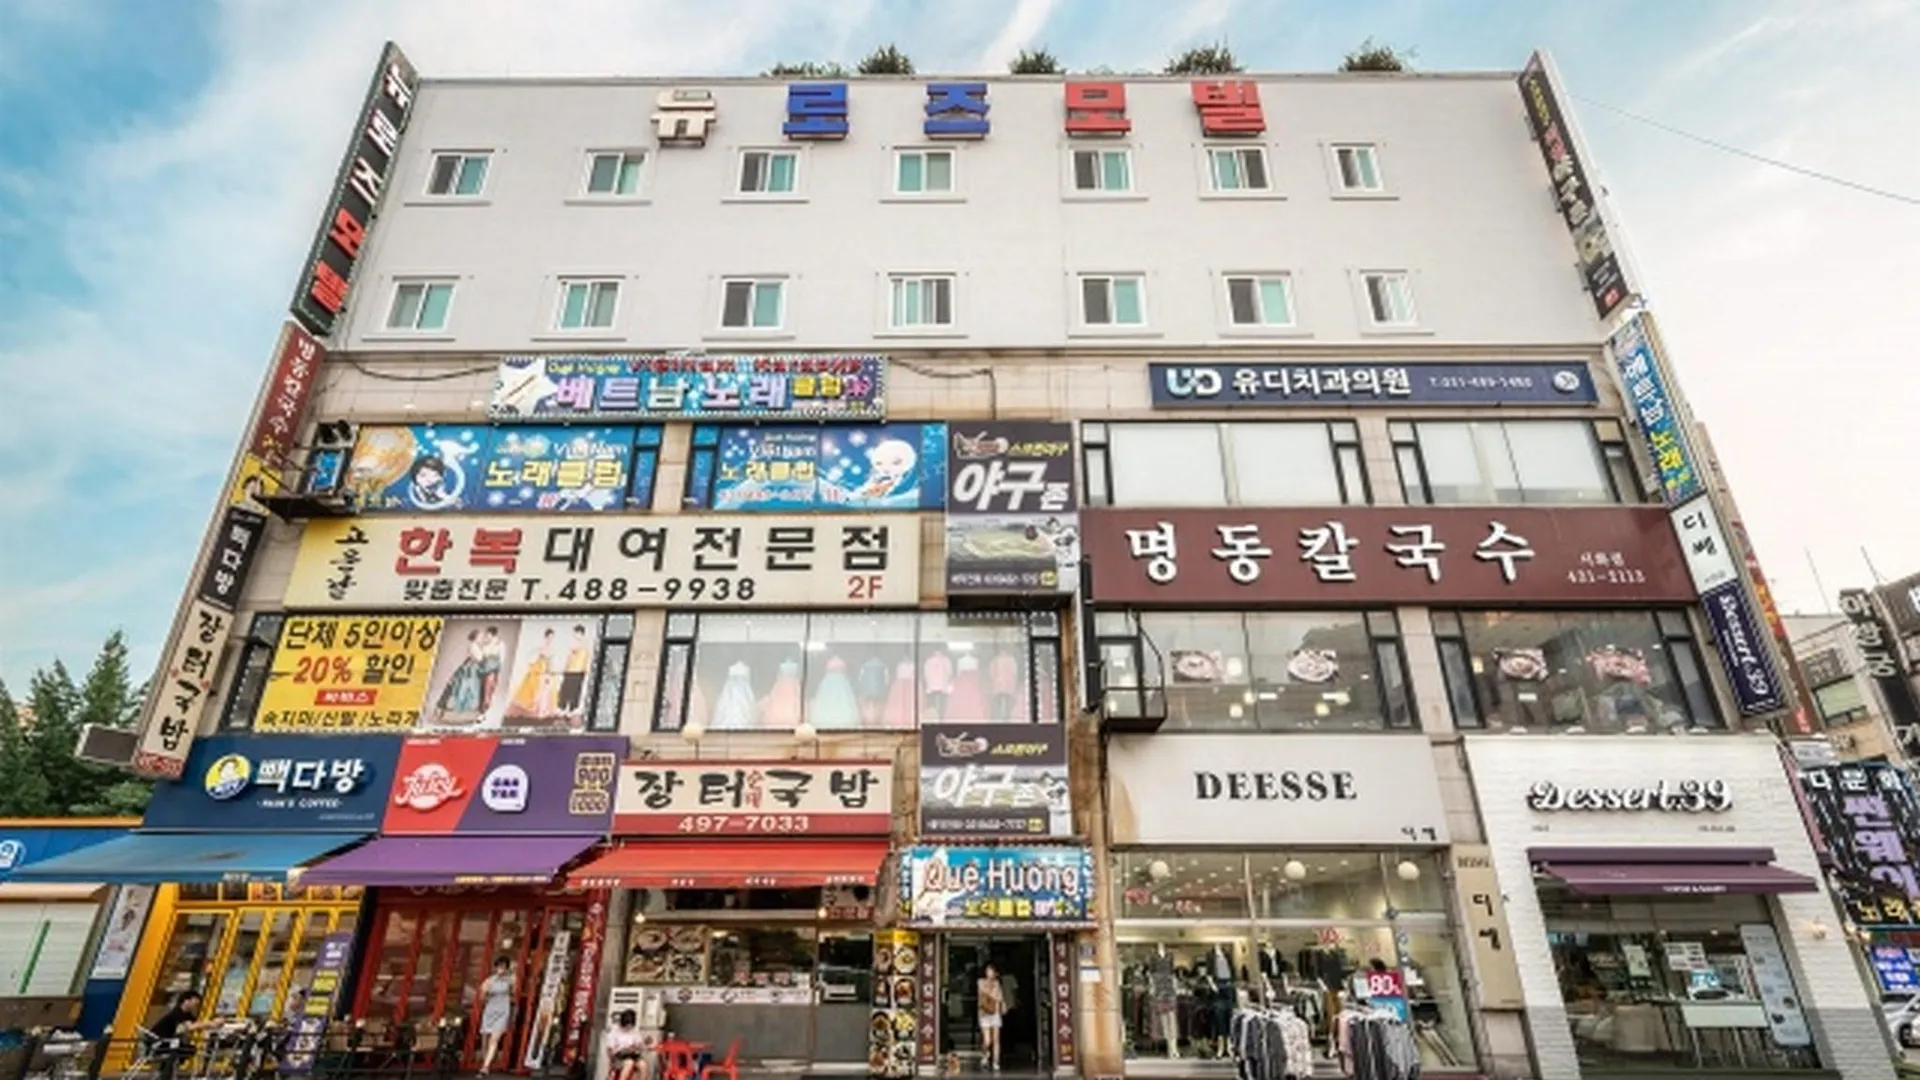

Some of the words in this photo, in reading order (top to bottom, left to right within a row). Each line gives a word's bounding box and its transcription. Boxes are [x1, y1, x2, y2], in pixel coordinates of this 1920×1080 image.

[1232, 368, 1411, 397] 유디치과의원
[1126, 523, 1535, 584] 명동칼국수
[847, 576, 883, 599] 2F
[286, 620, 337, 650] 단체
[344, 620, 441, 652] 5인이상
[293, 657, 352, 685] 20%
[361, 655, 415, 684] 할인
[256, 758, 365, 794] 빽다방
[1195, 772, 1357, 801] DEESSE
[678, 815, 810, 832] 497-7033
